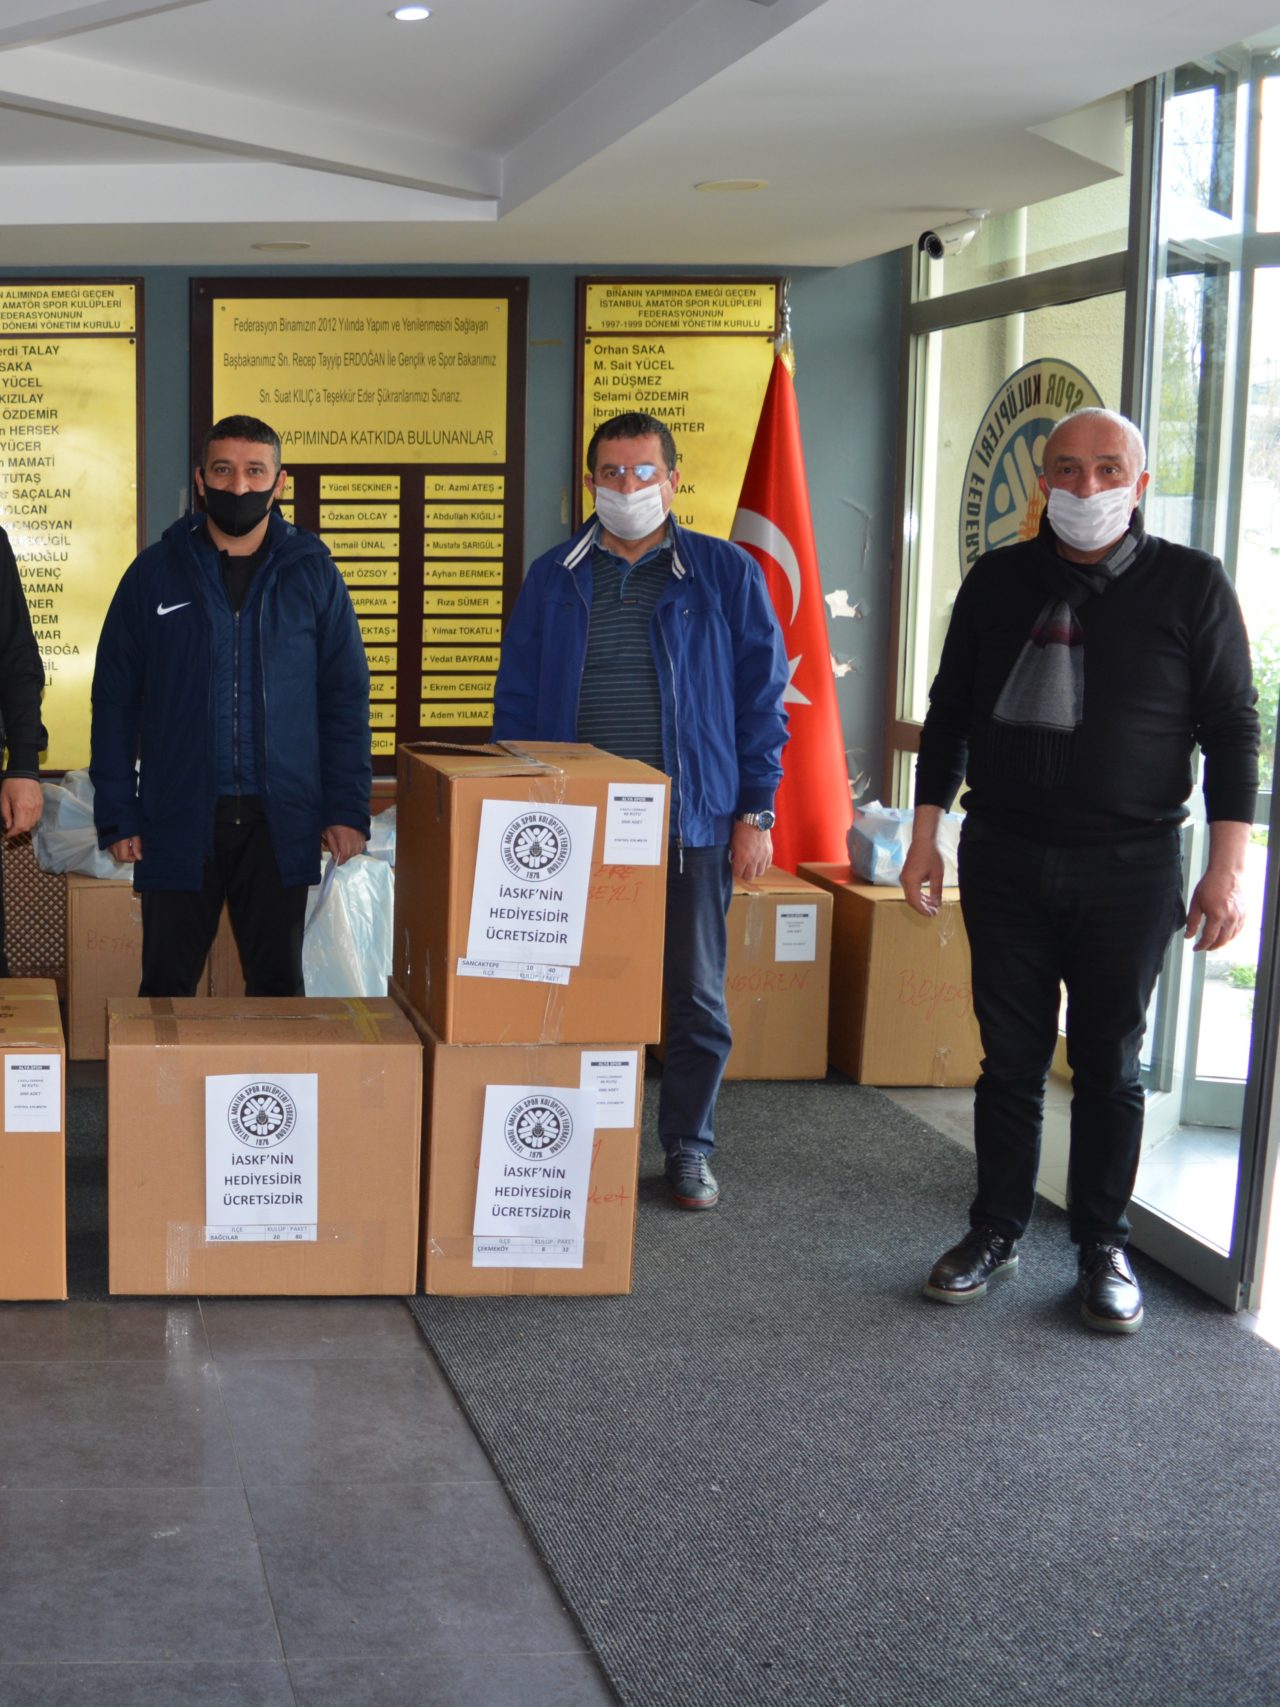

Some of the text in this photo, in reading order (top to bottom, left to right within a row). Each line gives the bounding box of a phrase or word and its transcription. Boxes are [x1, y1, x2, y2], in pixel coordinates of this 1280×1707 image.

[6, 291, 49, 299] ALIMINDA
[82, 290, 114, 299] GEÇEN
[644, 289, 693, 297] YAPIMINDA
[725, 289, 755, 297] GEÇEN
[686, 299, 710, 307] SPOR
[639, 310, 723, 318] FEDERASYONUNUN
[83, 321, 120, 329] KURULU
[234, 317, 488, 335] Federasyon Binamızın 2012 Yılında Yapım ve Yenilenmesini Sağlayan
[601, 320, 642, 328] 1997-1999
[22, 346, 59, 355] TALAY
[594, 345, 665, 355] Orhan SAKA
[224, 353, 275, 369] Başbakanımız
[278, 353, 289, 366] Sn.
[293, 353, 316, 369] Recep
[318, 353, 342, 369] Tayyip
[344, 350, 385, 367] ERDOĞAN
[398, 352, 425, 369] Gençlik
[428, 356, 436, 366] ve
[439, 352, 454, 368] Spor
[458, 352, 496, 366] Bakanımız
[594, 358, 674, 370] M. Sait YÜCEL
[0, 363, 32, 372] SAKA
[2, 376, 42, 388] YÜCEL
[594, 373, 661, 388] Ali DÜŞMEZ
[0, 394, 44, 403] KIZILAY
[260, 389, 271, 402] Sn.
[274, 389, 291, 402] Suat
[323, 388, 356, 405] Teşekkür
[358, 389, 375, 402] Eder
[377, 388, 429, 405] Şükranlarımızı
[594, 389, 689, 401] Selami ÖZDEMİR
[3, 408, 57, 419] ÖZDEMİR
[10, 426, 59, 435] HERSEK
[281, 430, 493, 445] YAPIMINDA KATKIDA BULUNANLAR
[0, 440, 41, 451] YÜCER
[8, 455, 55, 467] MAMATİ
[3, 474, 41, 485] TUTAŞ
[328, 481, 392, 493] Yücel SEÇKİNER
[448, 483, 468, 492] Azmi
[471, 484, 494, 493] ATEŞ
[12, 489, 70, 501] SAÇALAN
[328, 512, 387, 521] Özkan OLCAY
[433, 513, 469, 521] Abdullah
[333, 539, 385, 549] İsmail ÜNAL
[433, 539, 494, 549] Mustafa SARIGÜL
[357, 567, 388, 577] ÖZSOY
[432, 570, 495, 579] Ayhan BERMEK
[457, 596, 489, 606] SÜMER
[432, 626, 493, 635] Yılmaz TOKATLI
[430, 654, 493, 663] Vedat BAYRAM
[430, 681, 492, 691] Ekrem CENGİZ
[430, 711, 489, 719] Adem YILMAZ
[489, 907, 569, 923] HEDİYESİDİR
[486, 926, 568, 944] ÜCRETSİZDİR
[225, 1173, 302, 1185] HEDİYESİDİR
[495, 1187, 571, 1199] HEDİYESİDİR
[223, 1193, 303, 1205] ÜCRETSİZDİR
[492, 1205, 571, 1219] ÜCRETSİZDİR
